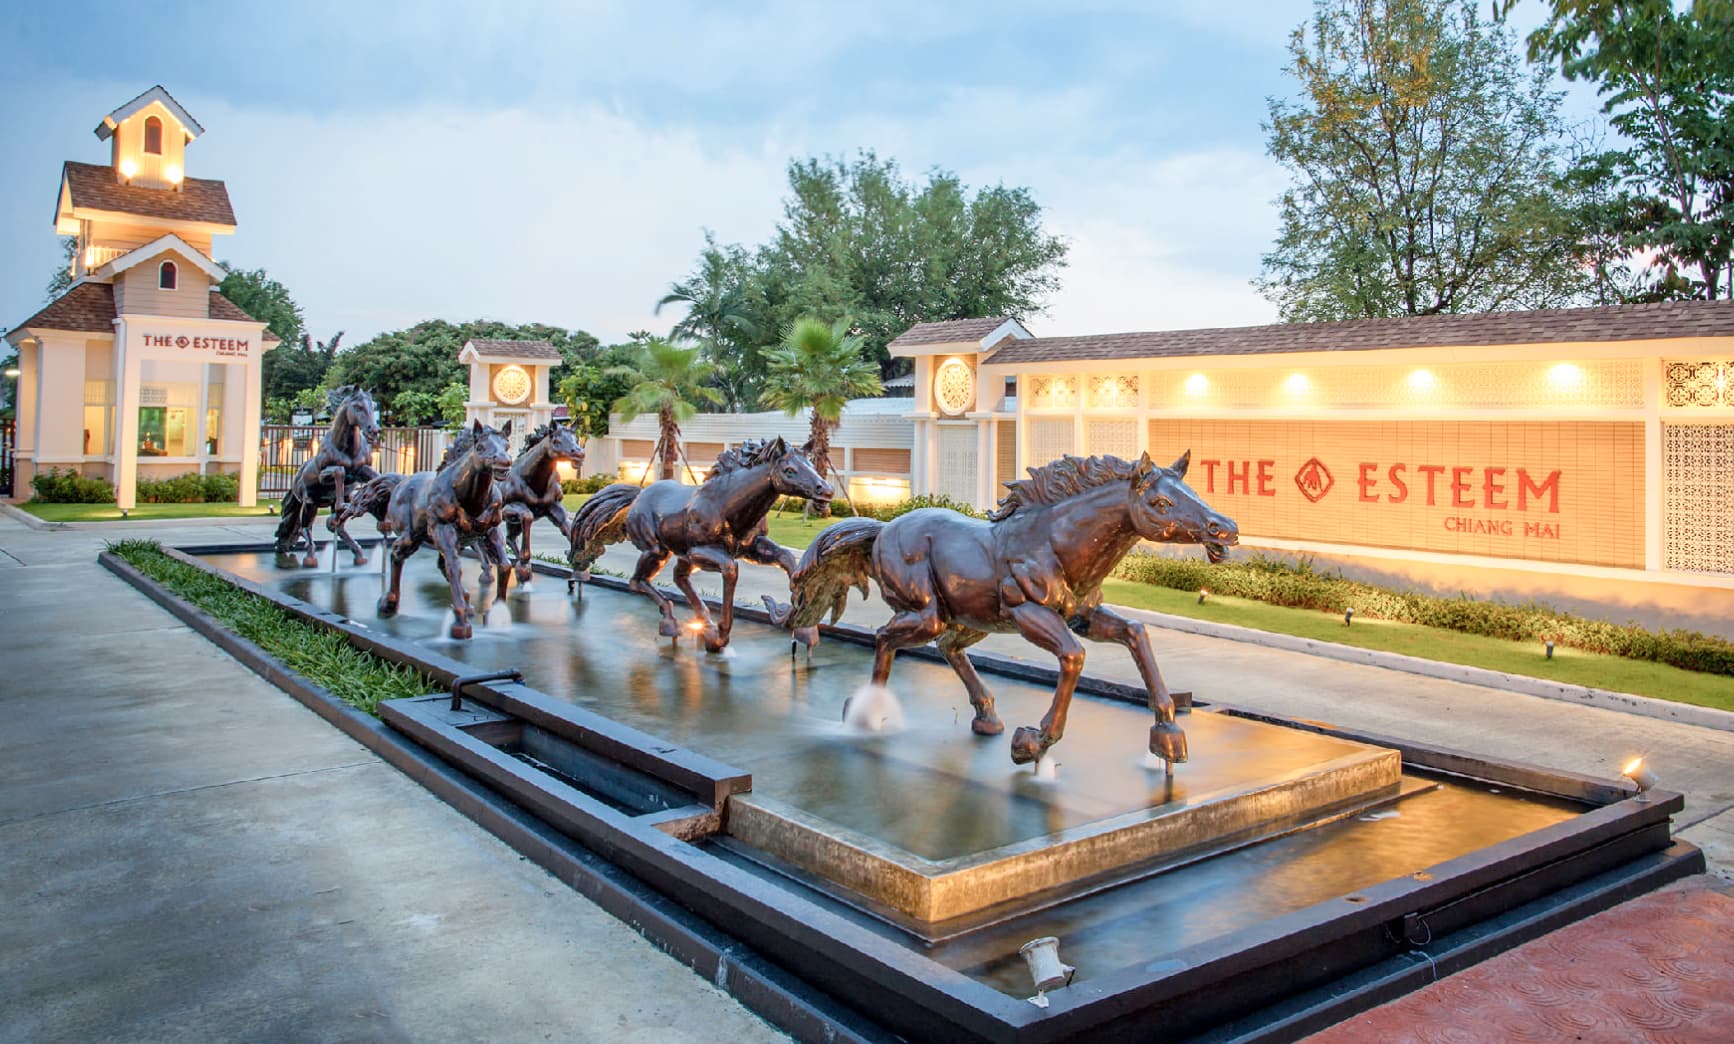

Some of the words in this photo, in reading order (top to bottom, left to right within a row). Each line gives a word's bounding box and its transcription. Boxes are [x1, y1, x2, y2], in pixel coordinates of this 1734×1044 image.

[143, 334, 173, 347] THE
[193, 336, 249, 351] ESTEEM
[1200, 459, 1276, 497] THE
[1357, 462, 1562, 513] ESTEEM
[1444, 516, 1513, 536] CHIANG
[1523, 522, 1561, 540] MAI
